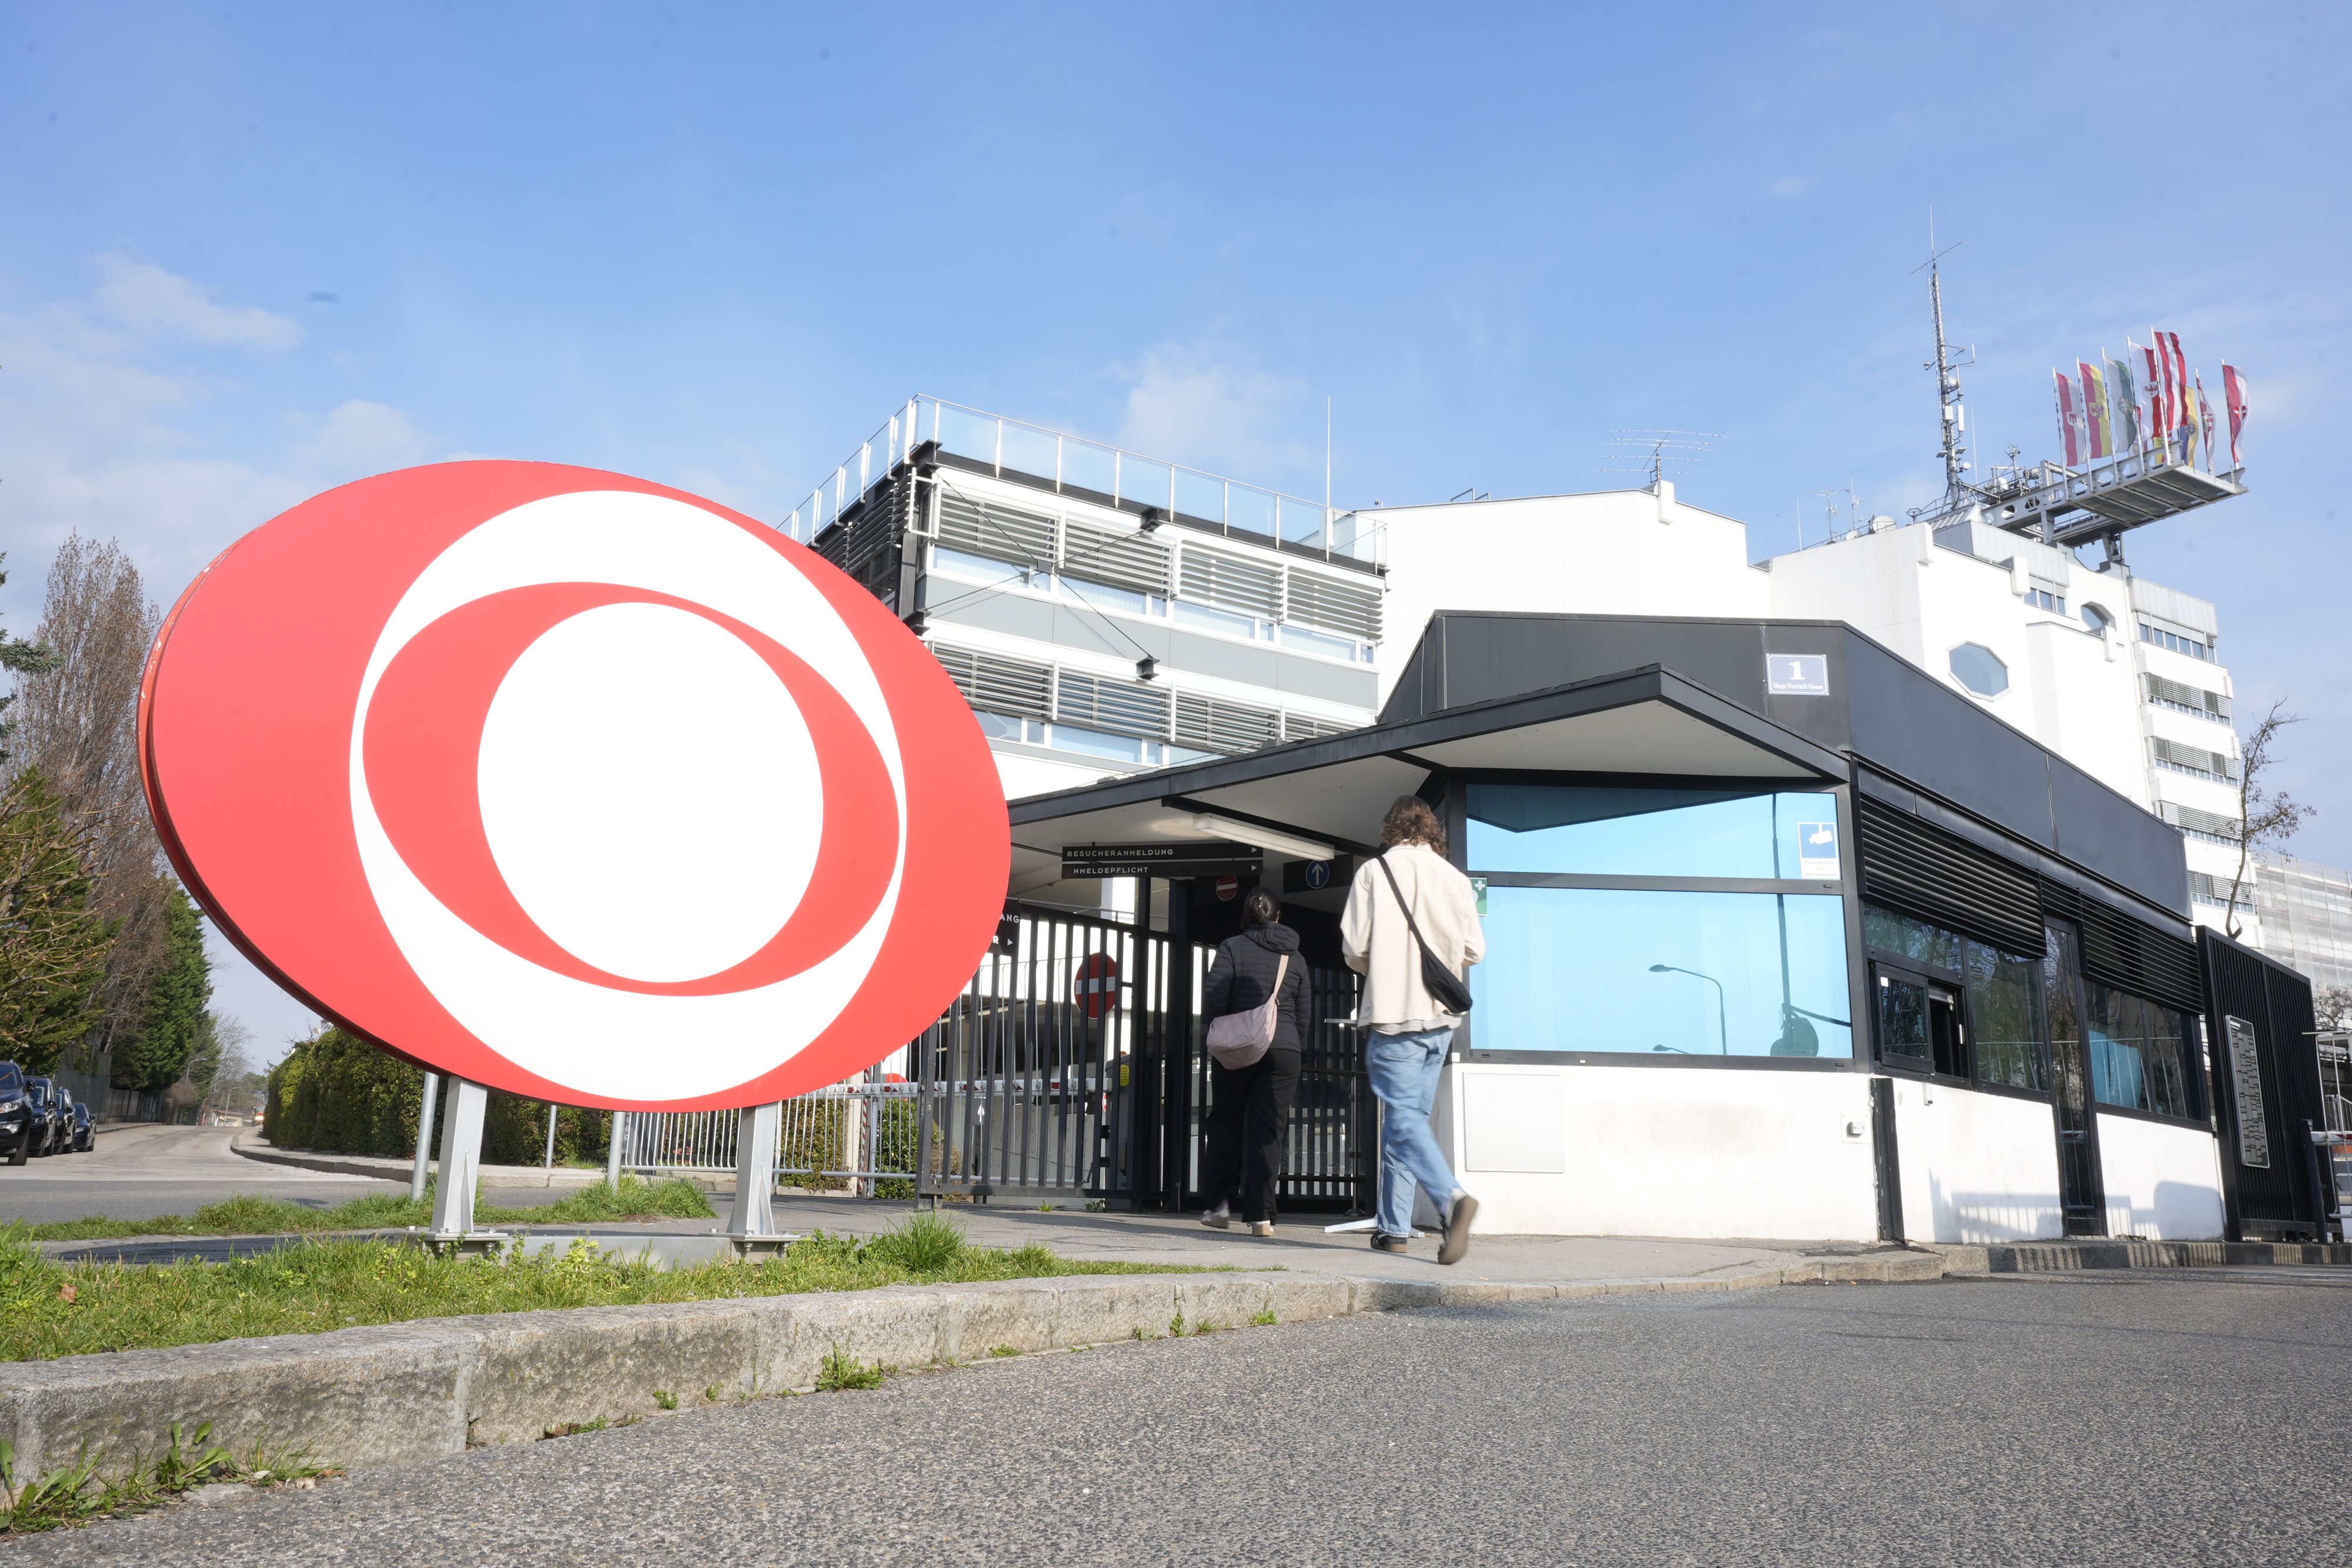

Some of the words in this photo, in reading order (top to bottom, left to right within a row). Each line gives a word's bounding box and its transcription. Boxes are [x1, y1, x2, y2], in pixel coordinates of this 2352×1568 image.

[1788, 661, 1806, 680] 1
[1067, 848, 1174, 857] BESUCHERANMELDUNG
[1000, 912, 1020, 923] ANG
